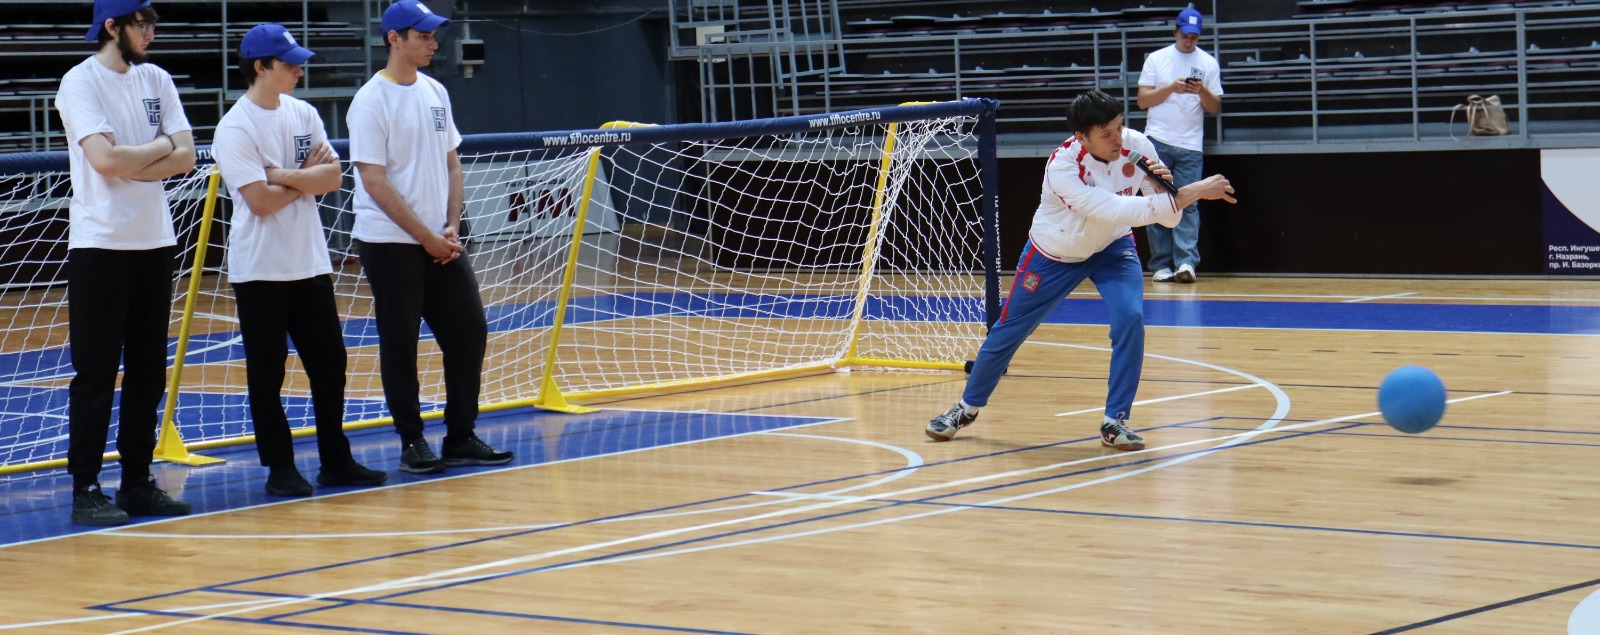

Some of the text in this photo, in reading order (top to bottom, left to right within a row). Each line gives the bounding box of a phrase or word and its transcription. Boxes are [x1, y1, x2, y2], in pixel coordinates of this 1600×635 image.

[808, 111, 881, 128] www.tiflocentre.ru
[542, 131, 631, 146] www.tiflocentre.ru
[1570, 244, 1600, 253] Ингуше
[1555, 253, 1589, 261] Назрань,
[1571, 261, 1600, 269] Базорк
